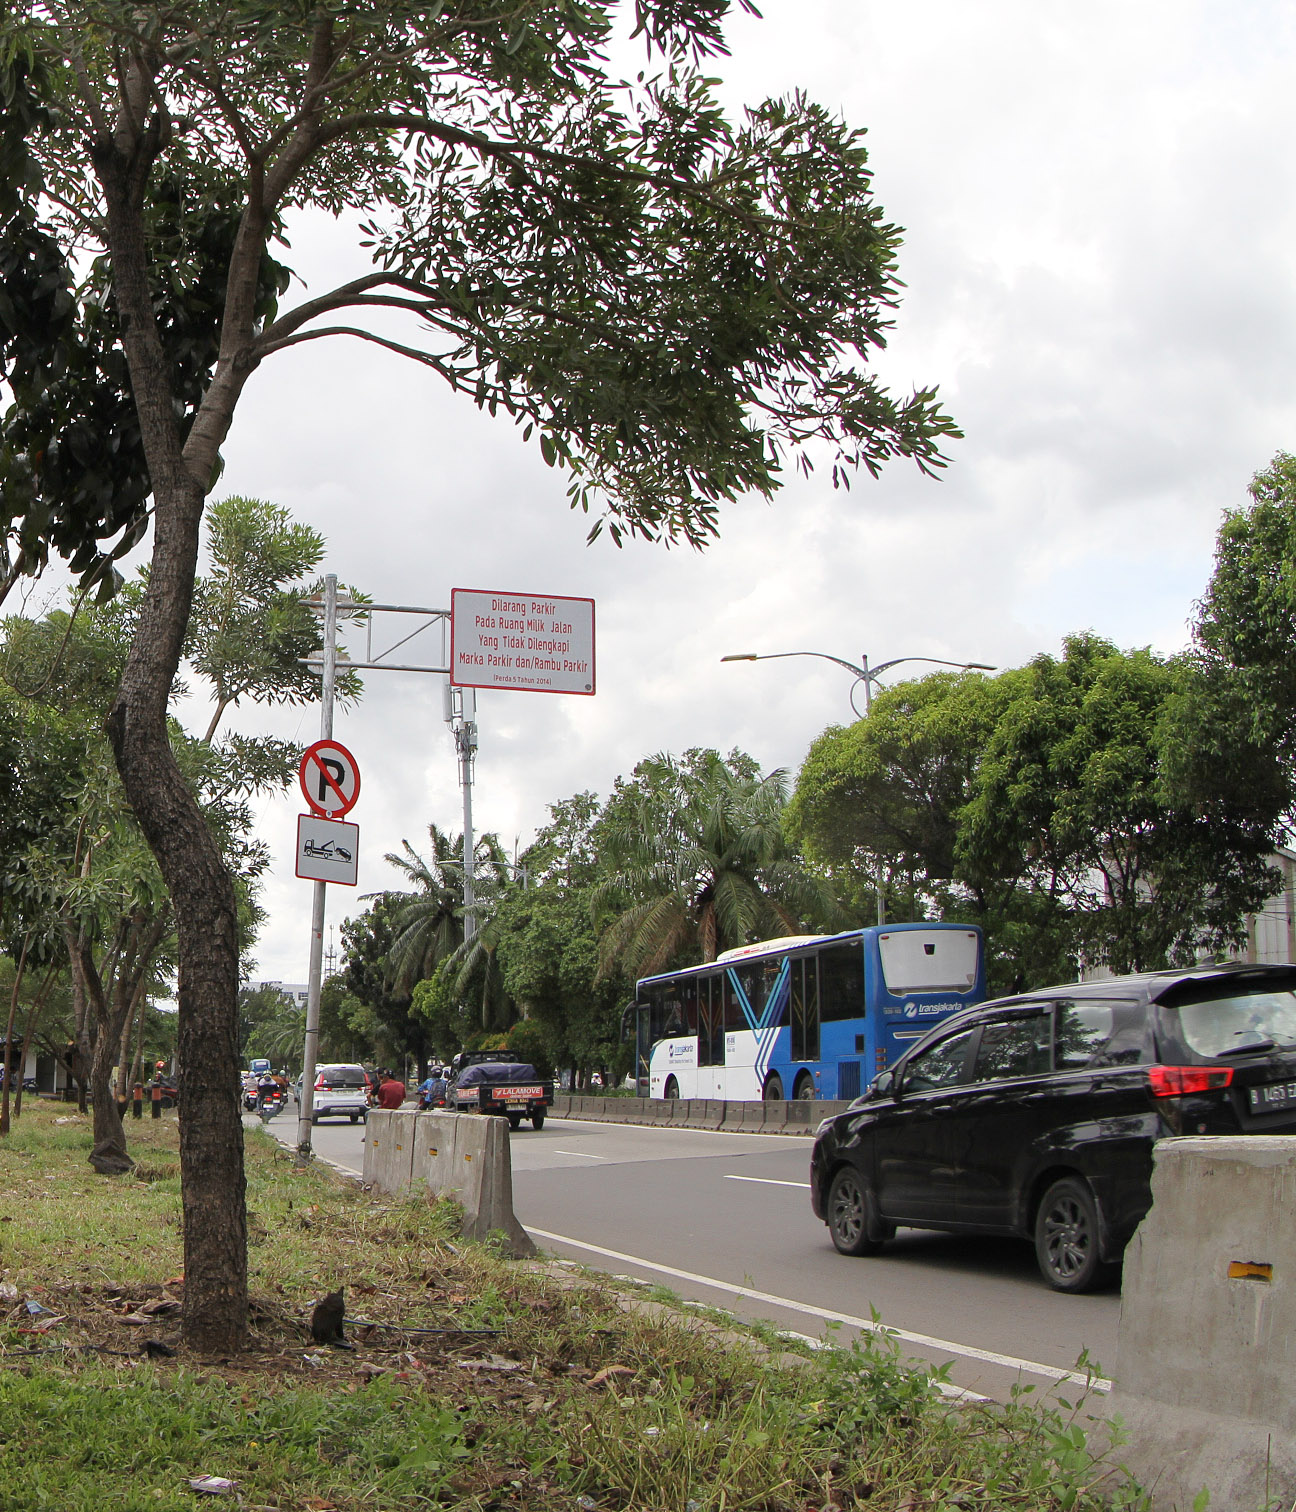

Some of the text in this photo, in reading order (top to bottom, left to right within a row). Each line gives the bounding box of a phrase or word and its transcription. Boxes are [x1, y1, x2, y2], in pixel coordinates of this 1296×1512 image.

[492, 599, 556, 616] Dilarang Parkir
[475, 616, 572, 634] Pada Ruang Milik Jalan
[478, 634, 570, 655] Yang Tidak Dilengkapi
[459, 652, 588, 673] Marka Parkir dan/Rambu Parkir
[517, 676, 535, 684] Tahun
[918, 1002, 963, 1015] transjakarta
[502, 1087, 541, 1095] LALAMOVE
